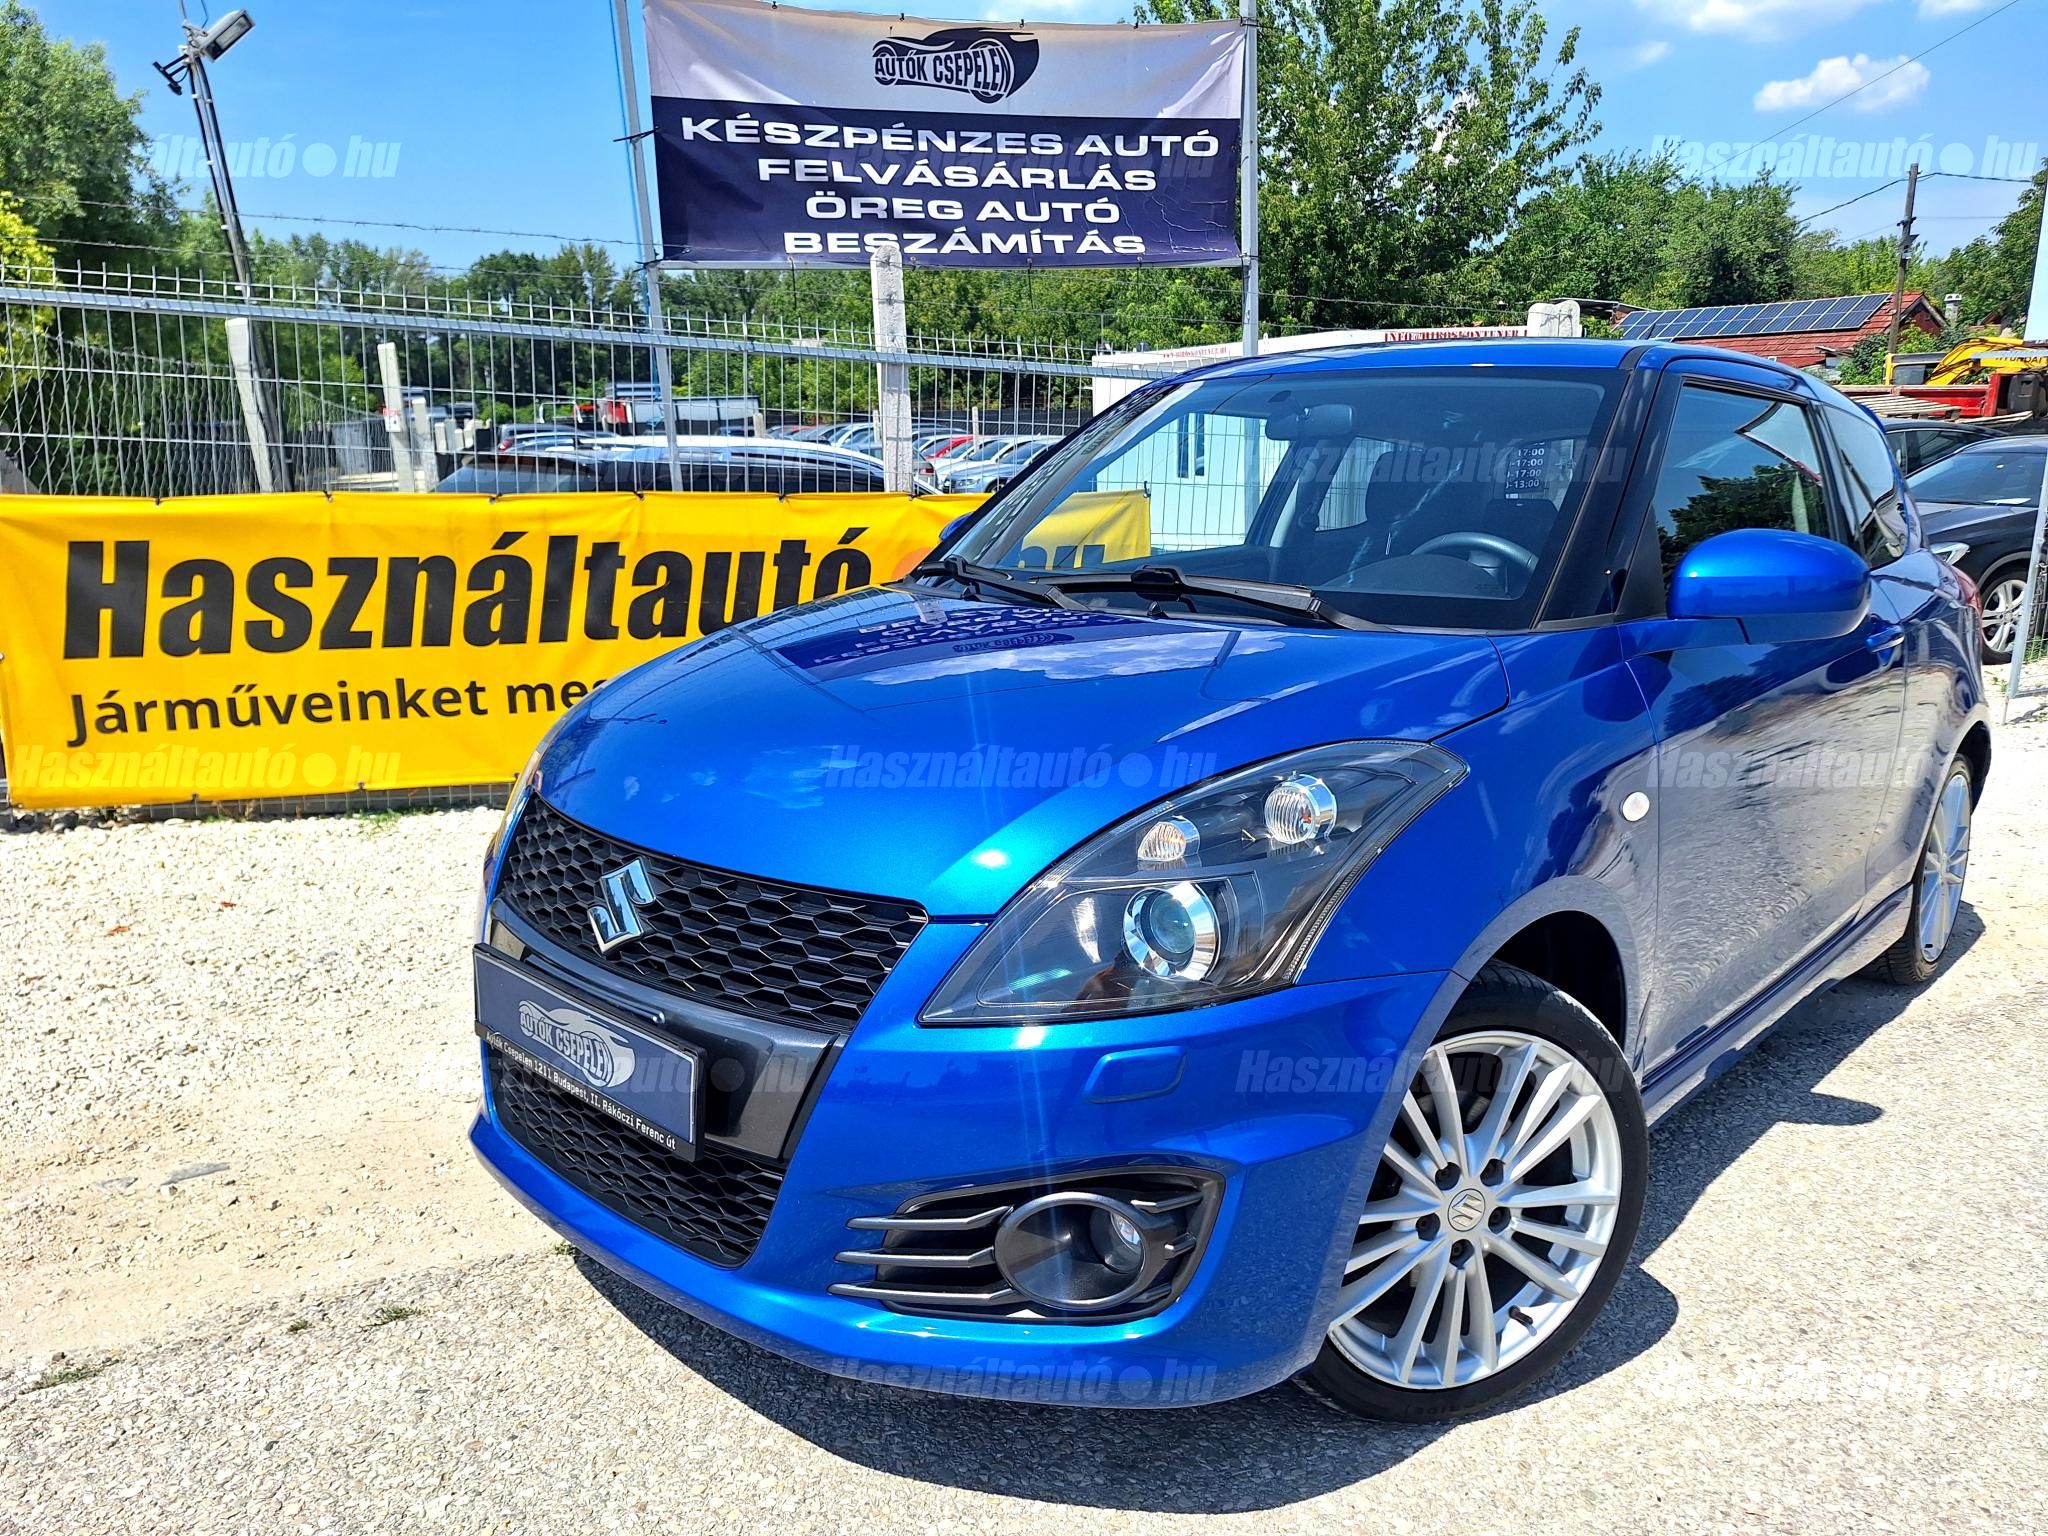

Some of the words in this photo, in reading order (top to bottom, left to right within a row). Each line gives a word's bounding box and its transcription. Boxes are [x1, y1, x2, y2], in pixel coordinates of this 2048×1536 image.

[874, 49, 928, 82] AUTÓK
[932, 46, 1014, 94] CSEPELEN
[681, 112, 1064, 156] KÉSZPÉNZES
[1074, 128, 1219, 158] AUTÓ
[757, 158, 1157, 192] FELVÁSÁRLÁS
[806, 190, 964, 221] ÖREG
[976, 196, 1120, 224] AUTÓ
[783, 225, 1146, 256] BESZÁMÍTÁS
[63, 526, 872, 660] Használtautó
[66, 678, 488, 748] Járműveinket
[506, 679, 608, 714] me
[520, 1012, 554, 1046] AUTÓK
[503, 1042, 533, 1067] Csepelen
[534, 1060, 552, 1080] 1211
[553, 1072, 589, 1101] Budapest,
[602, 1099, 634, 1127] Rákóczi
[635, 1118, 664, 1144] Ferenc
[666, 1135, 676, 1150] út
